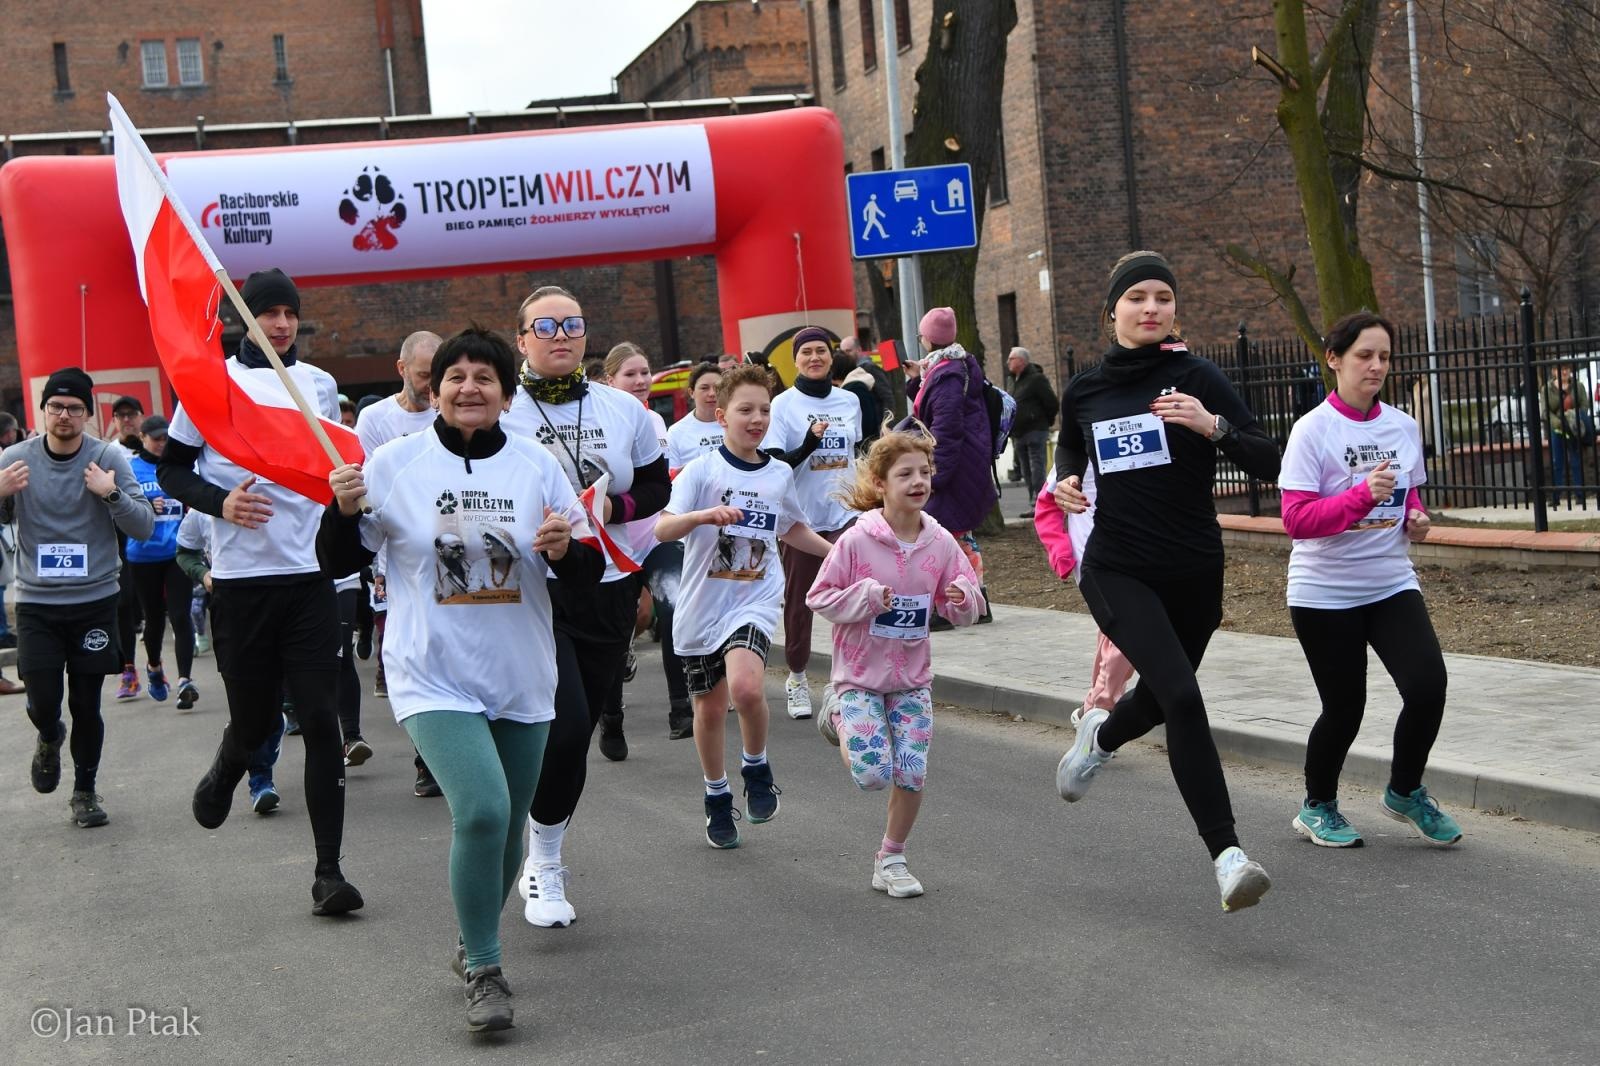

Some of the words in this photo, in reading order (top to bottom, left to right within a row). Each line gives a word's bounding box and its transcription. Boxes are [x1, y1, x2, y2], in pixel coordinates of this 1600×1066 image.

[219, 191, 299, 209] Raciborskie
[446, 220, 475, 231] BIEG
[478, 217, 527, 228] PAMIĘCI
[530, 211, 596, 225] ŻOŁNIERZY
[600, 204, 670, 219] WYKLĘTYCH
[224, 228, 272, 245] Kultury
[821, 437, 840, 449] 106
[1117, 434, 1144, 456] 58
[461, 490, 489, 498] TROPEM
[462, 498, 515, 510] WILCZYM
[747, 511, 767, 528] 23
[54, 555, 73, 568] 76
[894, 610, 916, 627] 22
